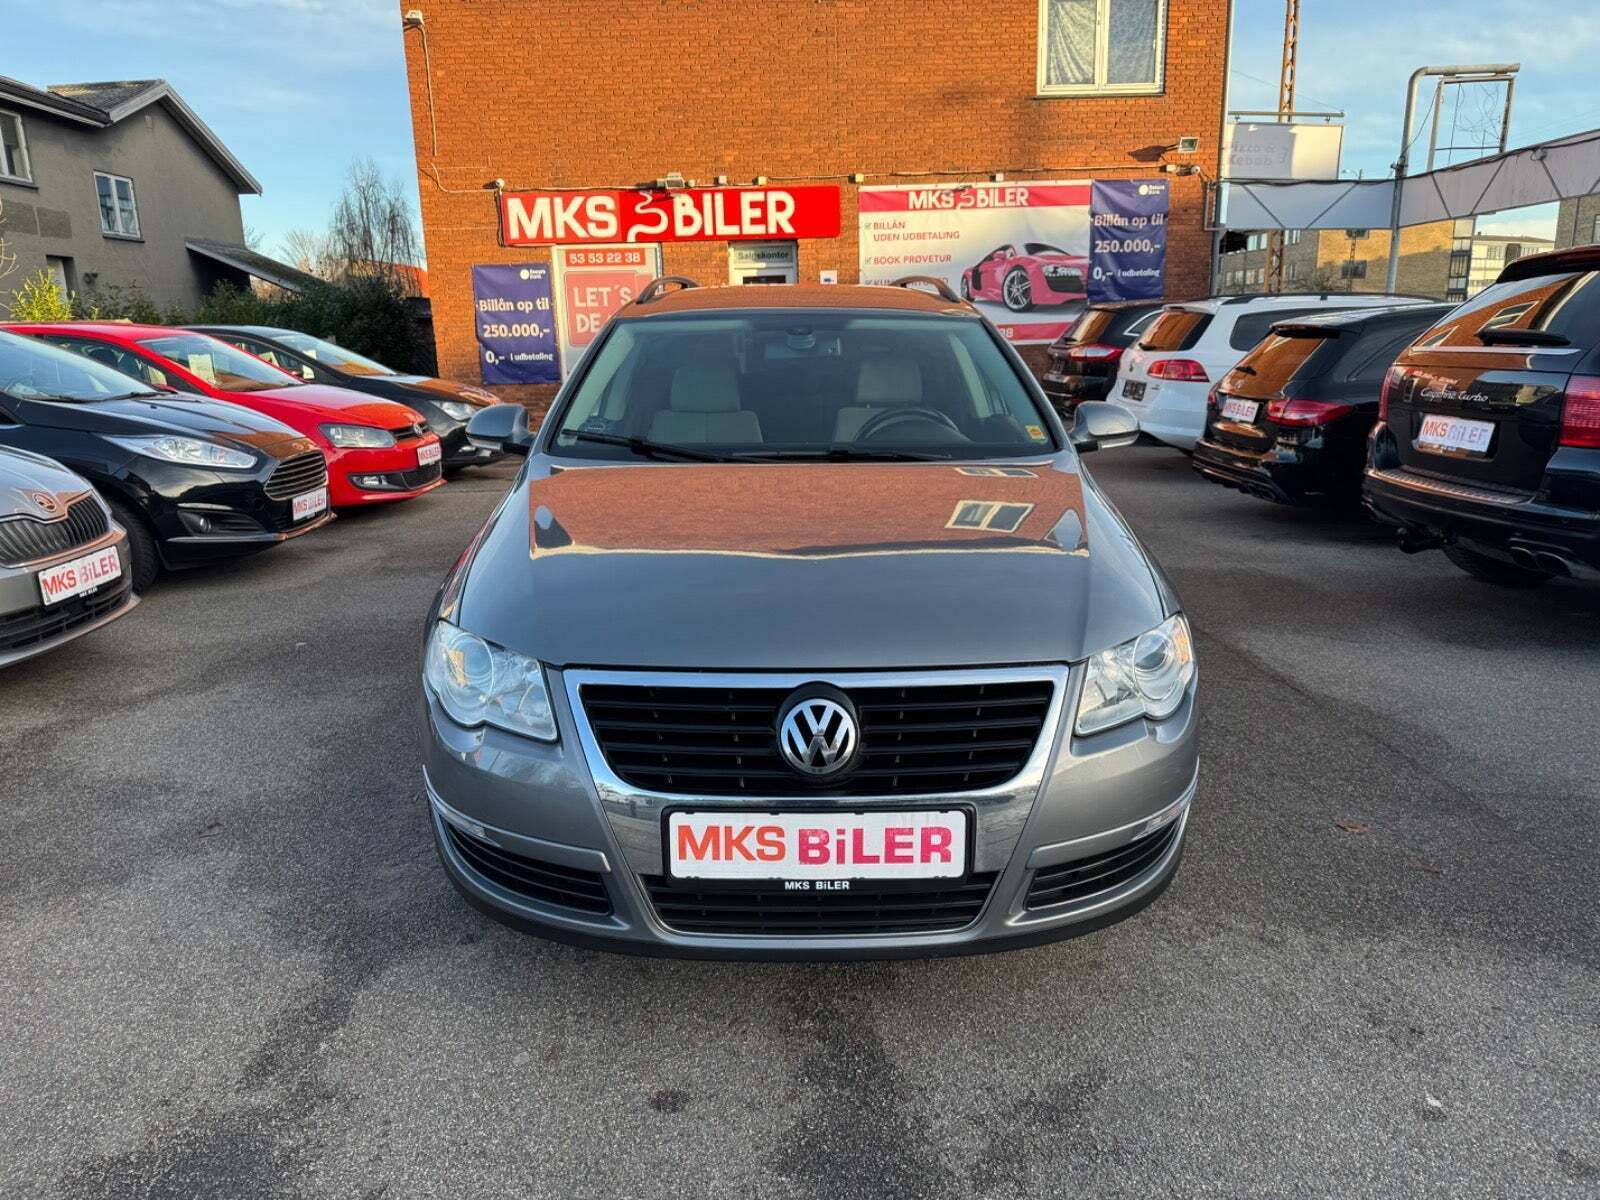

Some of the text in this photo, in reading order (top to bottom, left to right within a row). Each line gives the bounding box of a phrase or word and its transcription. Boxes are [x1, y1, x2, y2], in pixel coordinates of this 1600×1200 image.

[908, 187, 1030, 210] MKS BILER
[507, 190, 796, 239] MKS BILER
[1094, 213, 1164, 229] Billån op til
[873, 221, 906, 230] BILLÅN
[873, 231, 961, 242] UDEN UDBETALING
[1094, 239, 1161, 254] 250.000,-
[569, 251, 641, 264] 53 53 22 38
[873, 255, 952, 265] BOOK PRØVETUR
[1122, 267, 1161, 278] udbetaling
[479, 297, 549, 314] Billån op til
[482, 323, 550, 338] 250.000,-
[515, 353, 554, 362] udbetaling
[1458, 390, 1489, 402] Turbo
[1423, 420, 1449, 438] MKS
[42, 569, 77, 595] MKS
[677, 825, 953, 865] MKS BiLER
[785, 881, 850, 890] MKS BiLER
